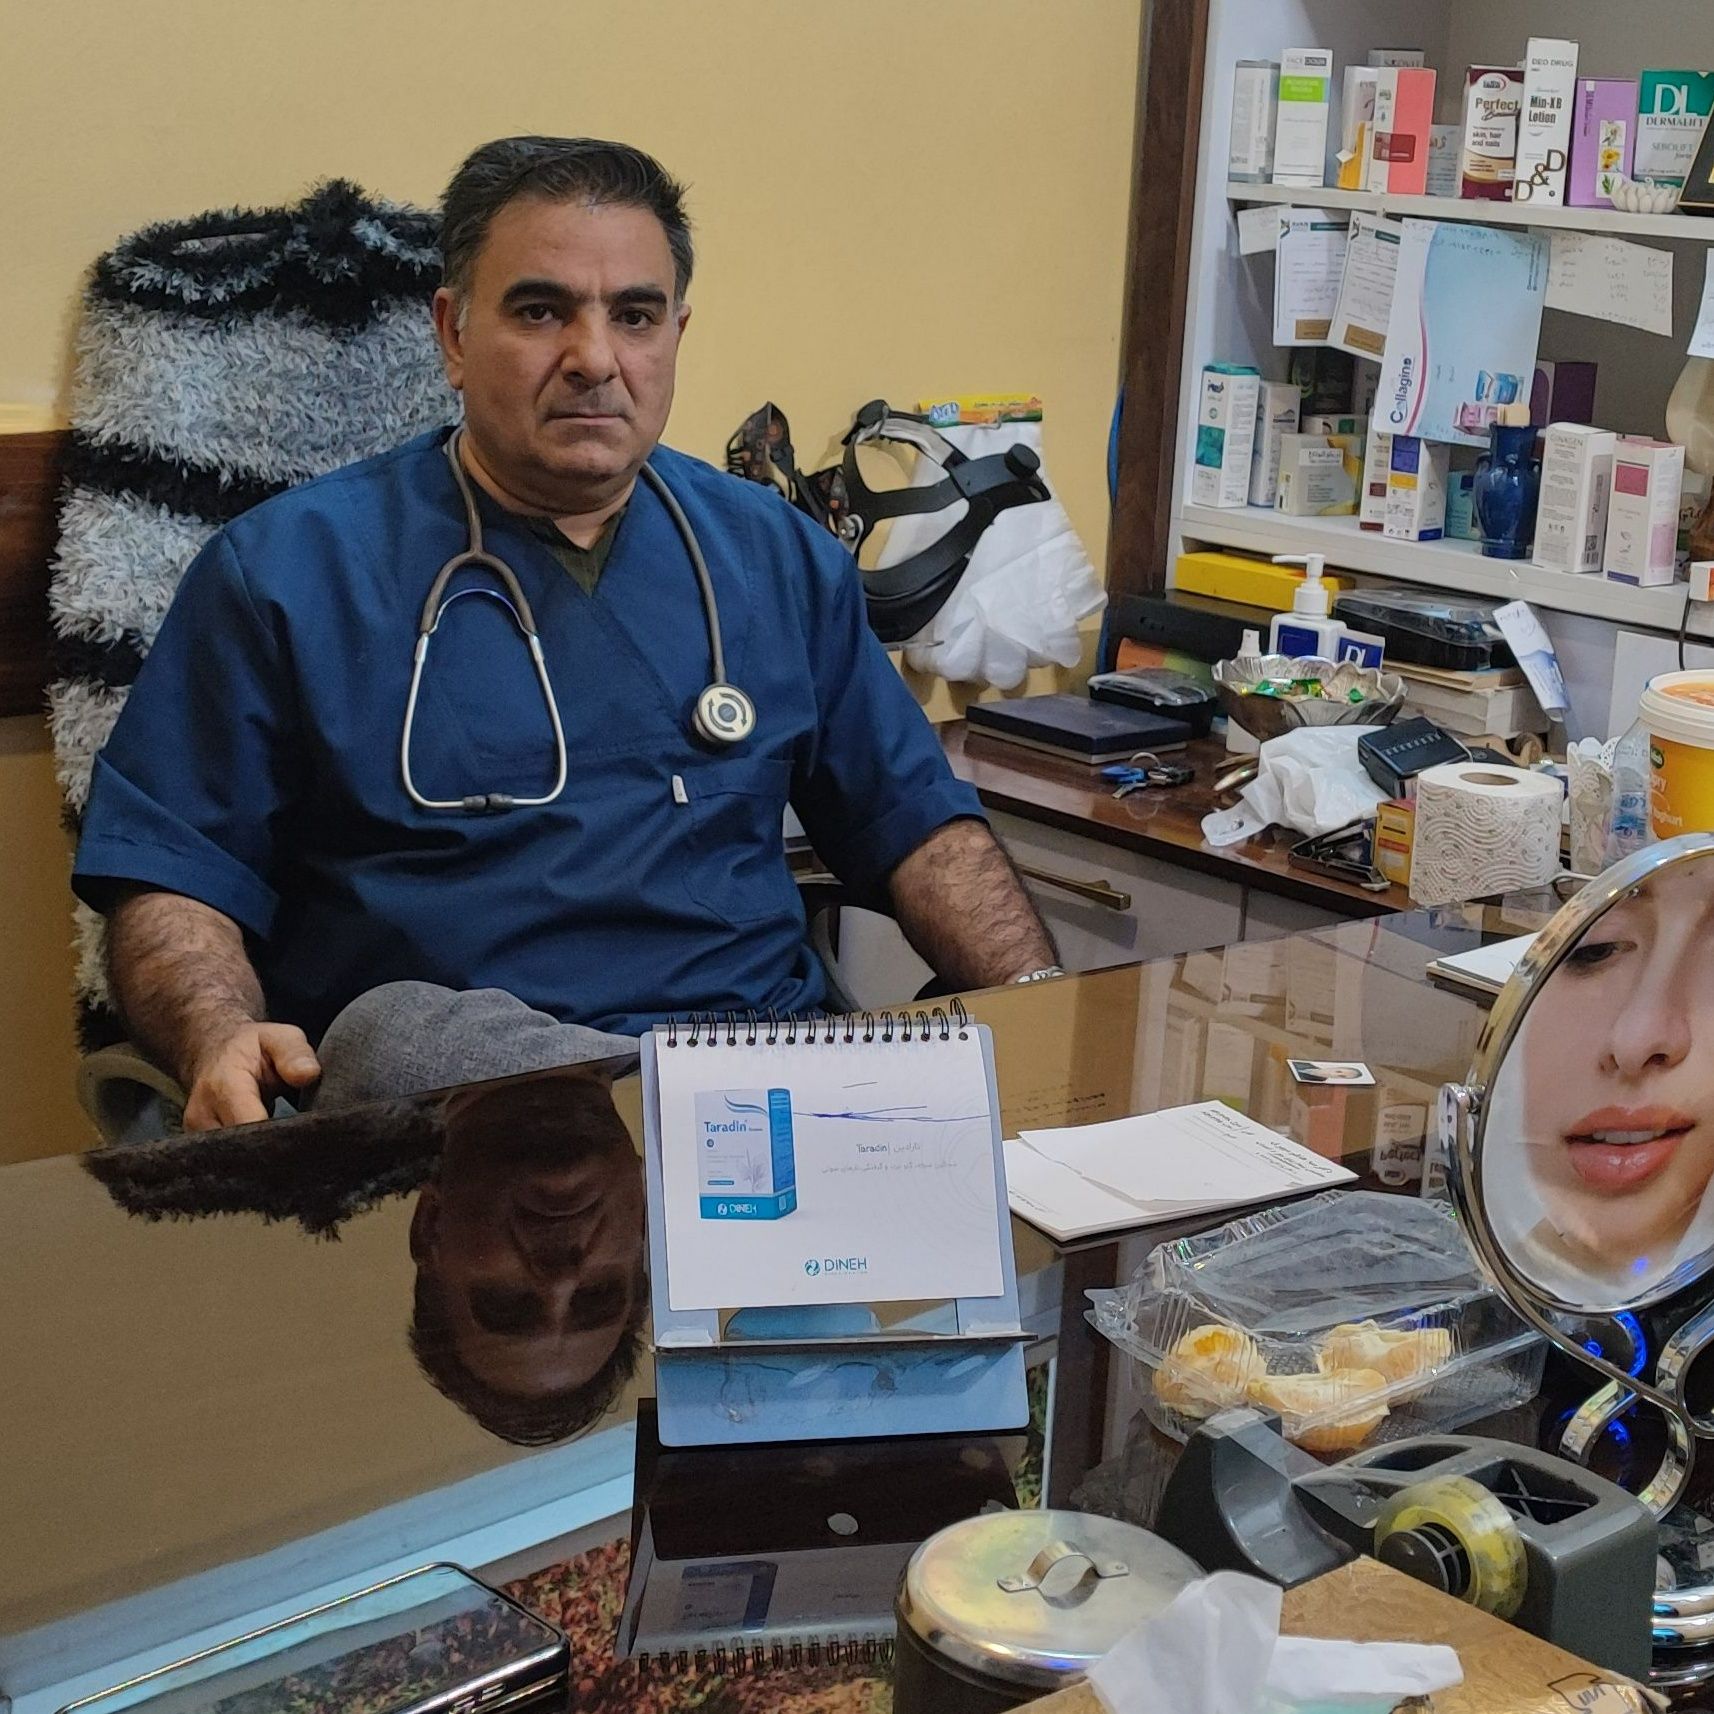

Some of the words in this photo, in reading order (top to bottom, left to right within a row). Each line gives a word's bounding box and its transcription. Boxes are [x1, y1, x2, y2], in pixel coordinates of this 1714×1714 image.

[1475, 97, 1520, 112] Perfect
[1652, 83, 1698, 117] DL
[1528, 111, 1556, 124] Lotion
[703, 1119, 747, 1133] Taradin
[824, 1258, 868, 1272] DINEH
